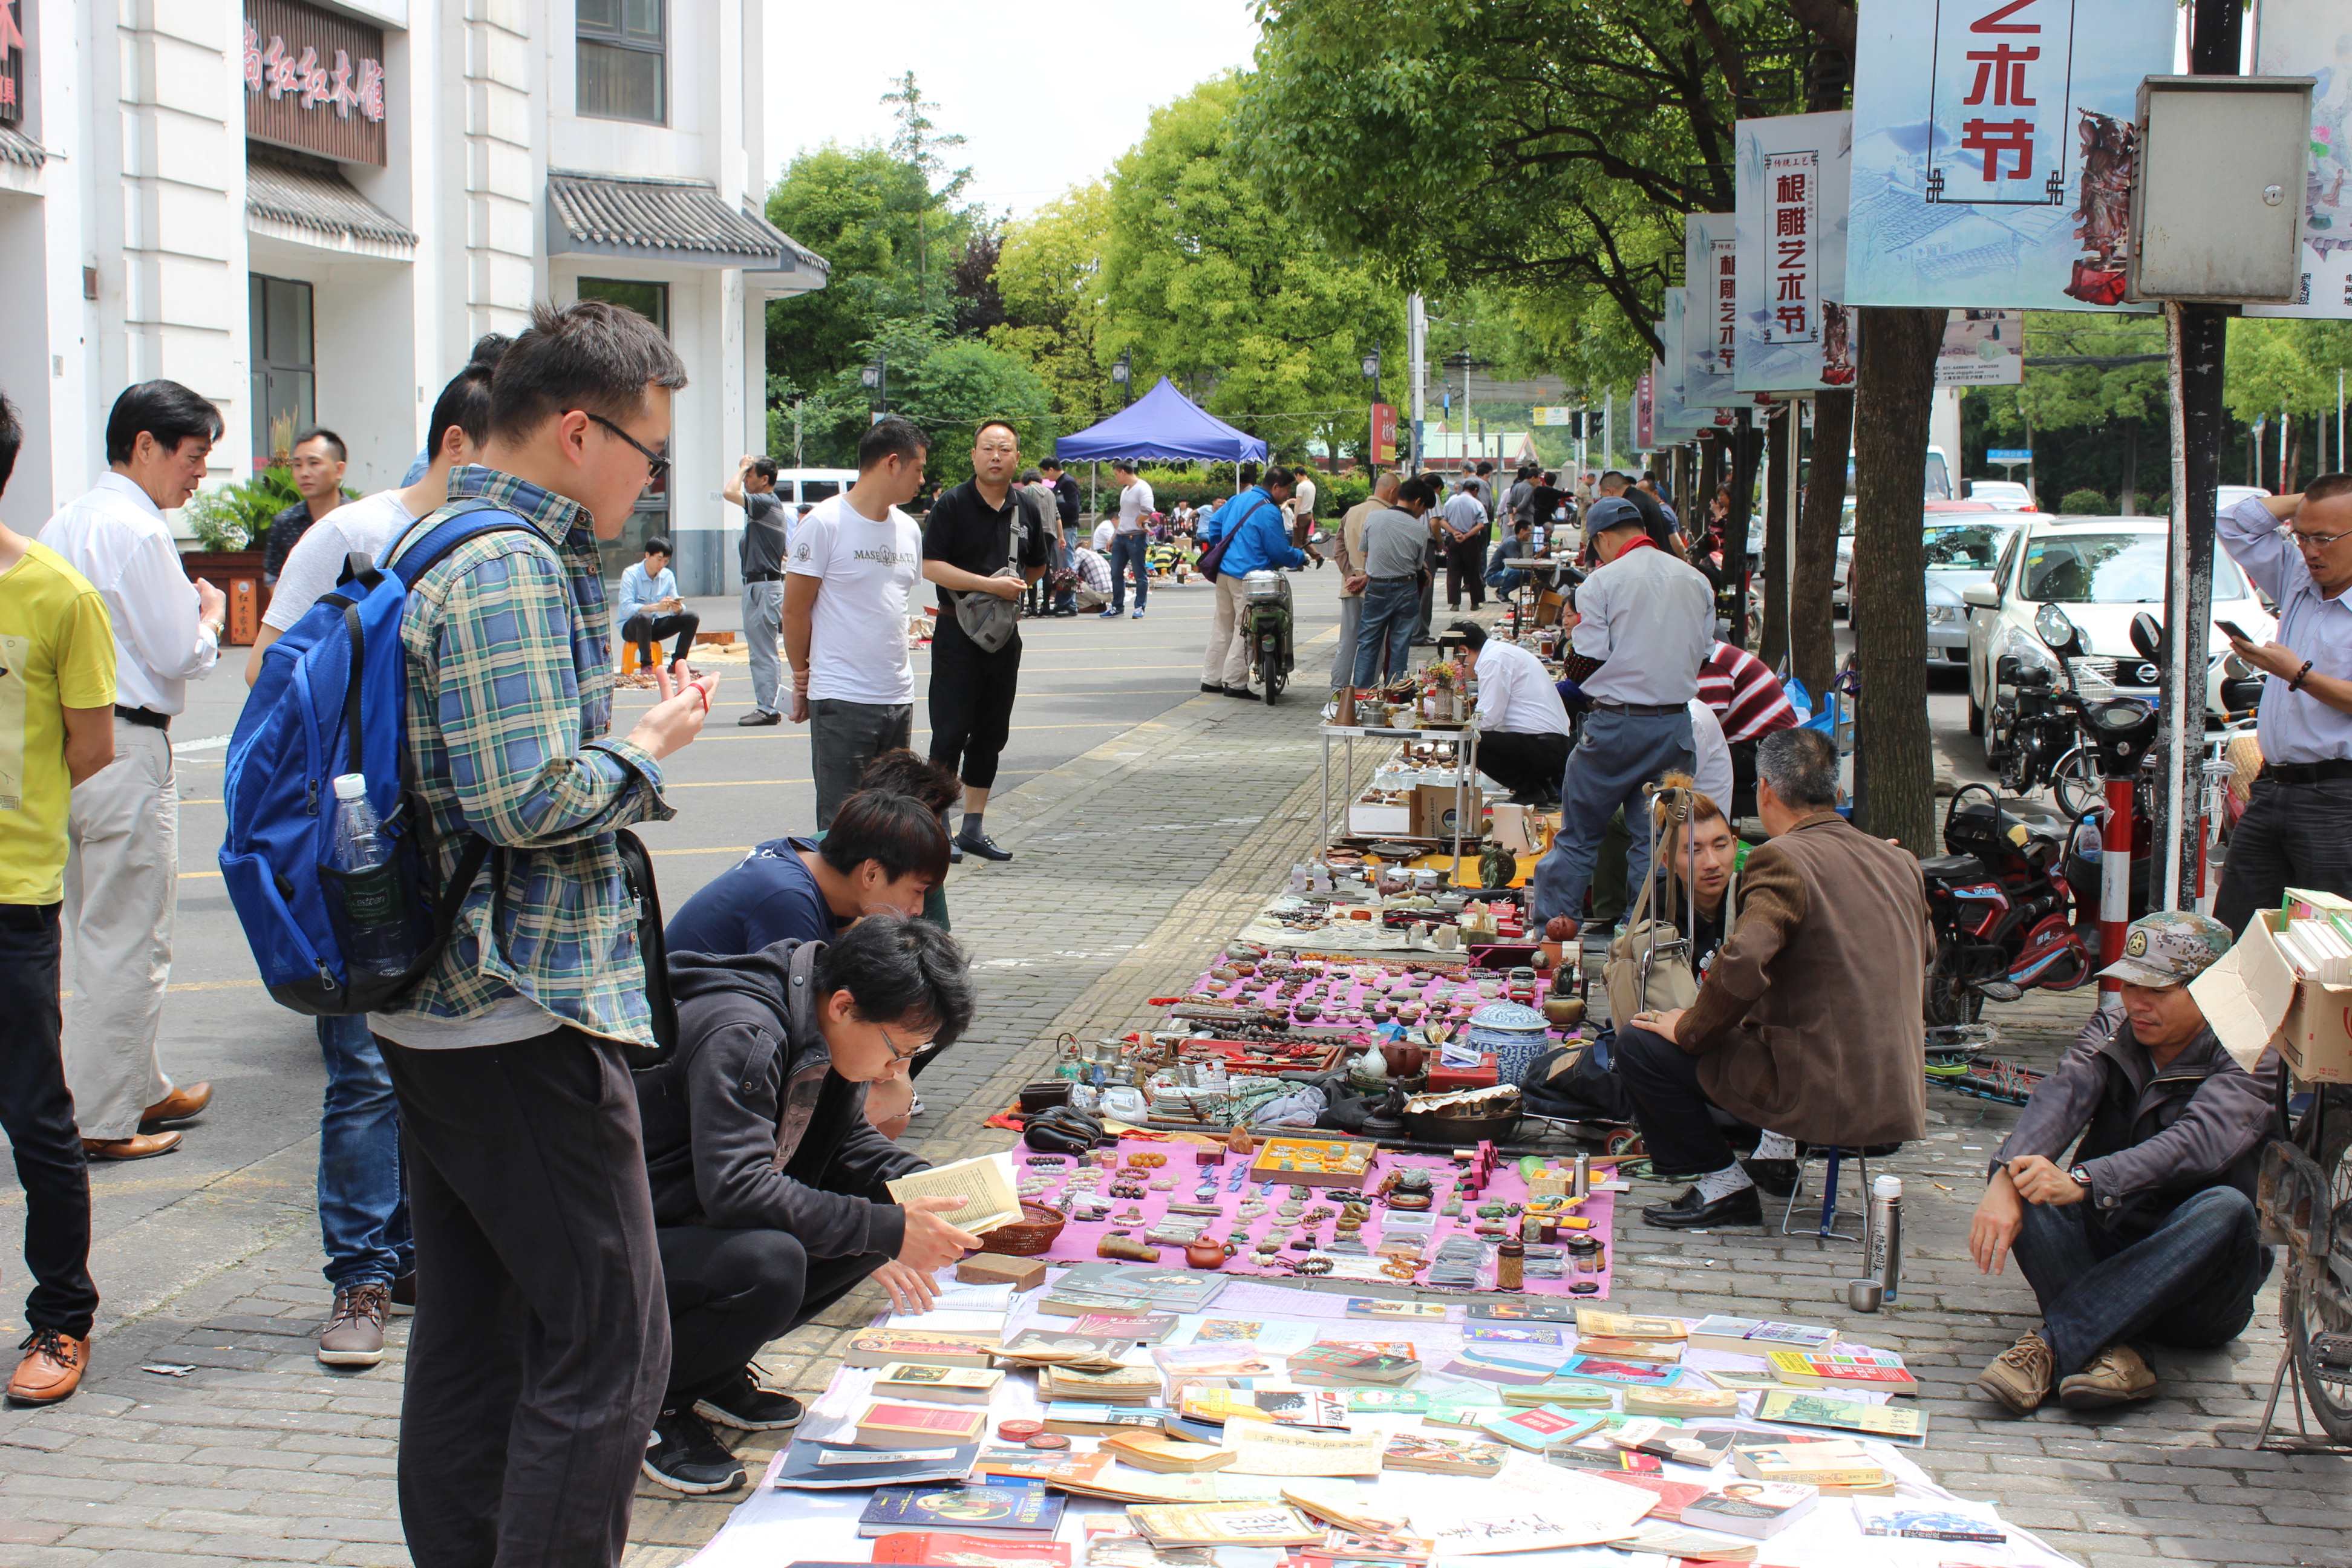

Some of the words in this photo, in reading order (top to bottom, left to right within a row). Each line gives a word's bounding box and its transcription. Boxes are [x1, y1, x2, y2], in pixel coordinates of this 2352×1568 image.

[1776, 174, 1806, 334] 根雕艺术节
